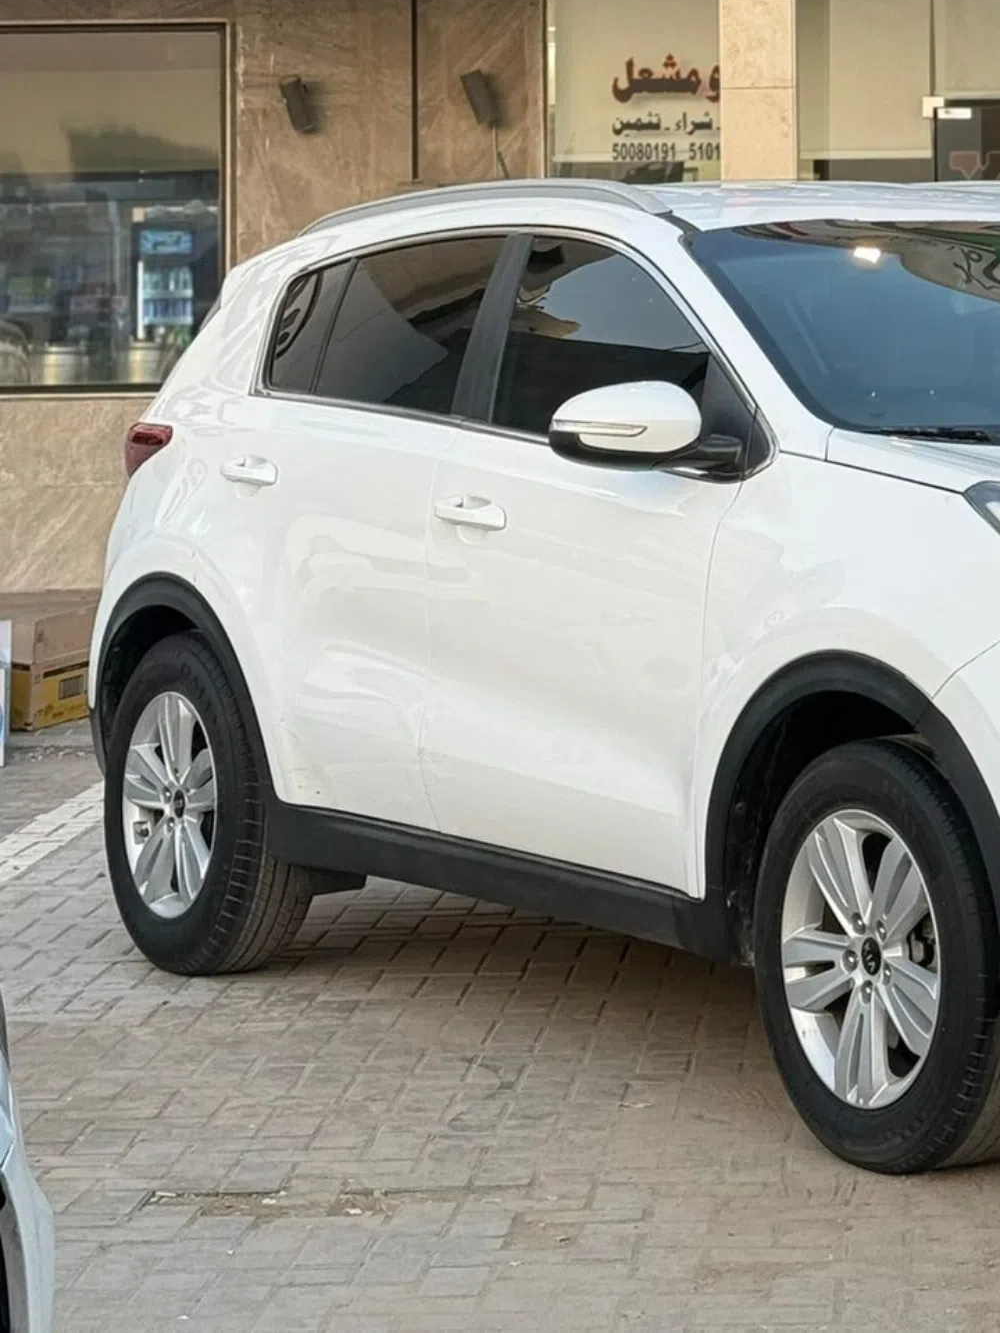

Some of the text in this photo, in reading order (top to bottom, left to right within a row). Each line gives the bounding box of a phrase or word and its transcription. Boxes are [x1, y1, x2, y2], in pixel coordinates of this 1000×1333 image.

[611, 52, 702, 104] مشعل
[611, 110, 662, 137] تثمين
[675, 110, 713, 136] شراء
[611, 142, 676, 161] 50080191
